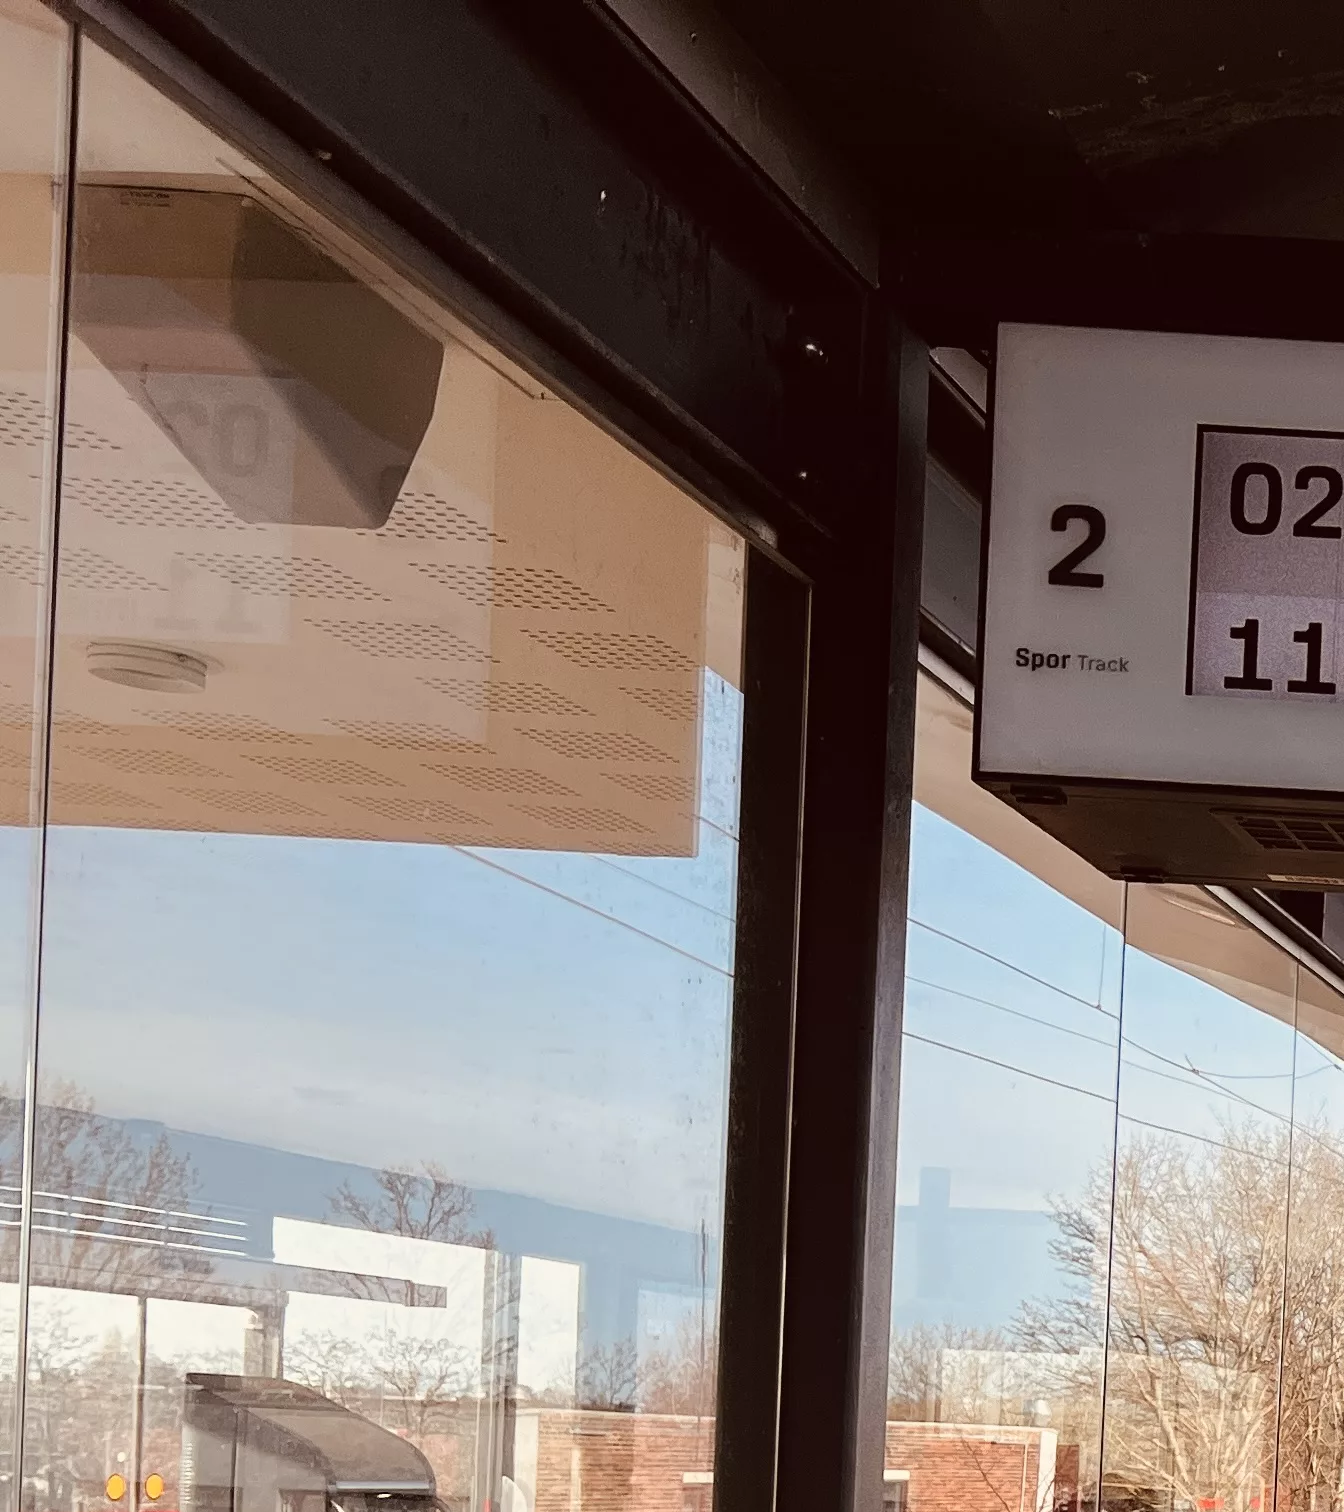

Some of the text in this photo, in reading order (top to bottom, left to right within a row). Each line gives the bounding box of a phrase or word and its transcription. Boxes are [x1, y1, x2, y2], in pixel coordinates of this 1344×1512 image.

[1229, 462, 1344, 539] 02
[1048, 504, 1106, 588] 2
[1016, 648, 1130, 673] Spor Track
[1223, 618, 1337, 695] 11
